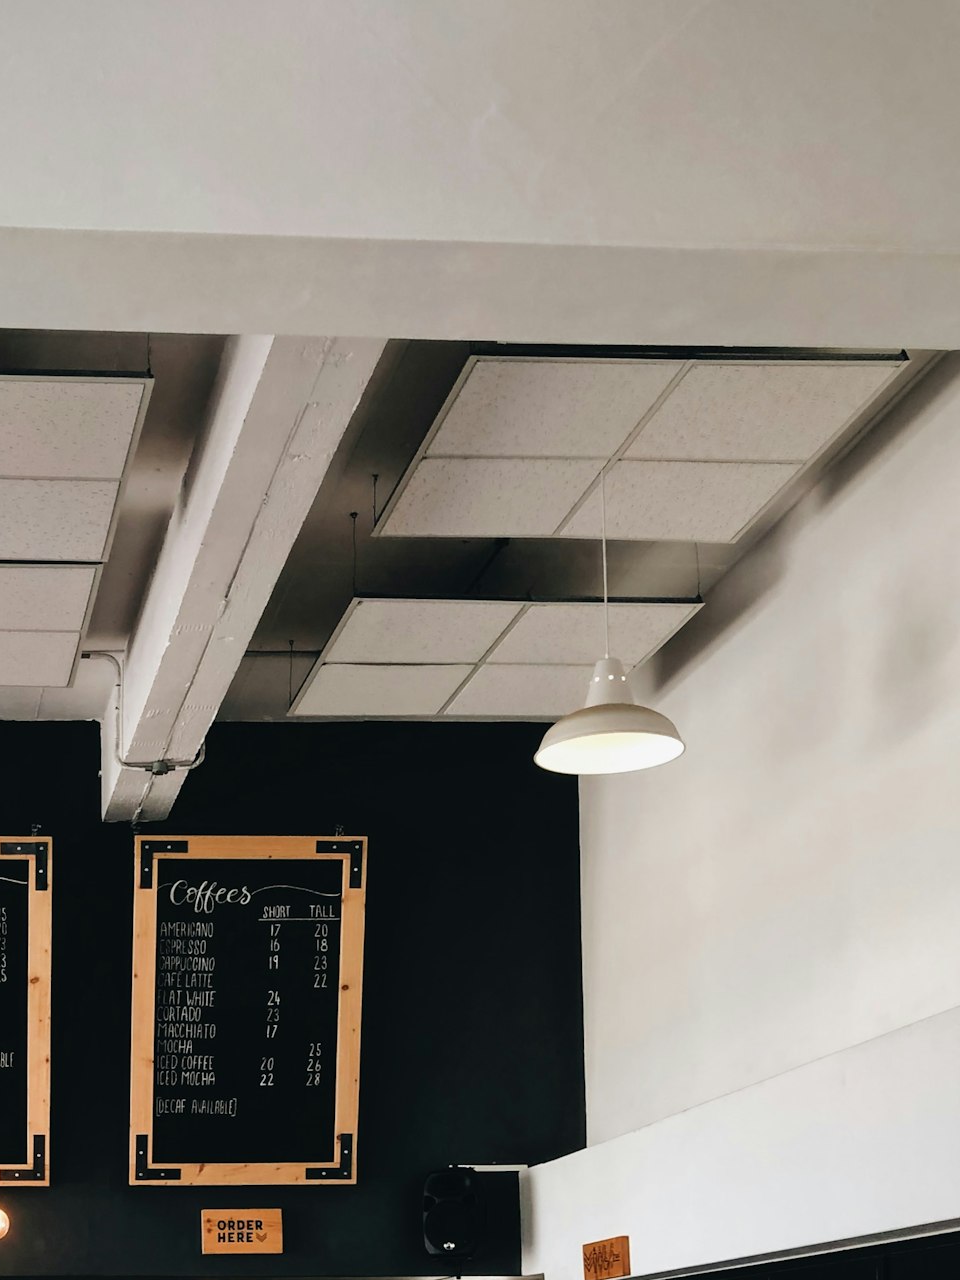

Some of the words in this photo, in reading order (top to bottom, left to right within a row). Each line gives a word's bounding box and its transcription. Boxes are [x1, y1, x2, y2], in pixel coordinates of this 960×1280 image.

[169, 880, 252, 914] Coffees
[262, 905, 291, 918] SHORT
[309, 904, 335, 917] TALL
[160, 921, 214, 938] AMERICANO
[270, 923, 281, 937] 17
[314, 923, 328, 937] 20
[160, 939, 207, 955] ESPRESSO
[270, 938, 280, 952] 16
[316, 938, 328, 952] 18
[159, 955, 215, 971] CAPPUCCINO
[268, 954, 279, 970] 19
[314, 955, 327, 971] 23
[185, 973, 213, 988] LATTE
[313, 973, 327, 988] 22
[157, 990, 183, 1005] FLAT
[186, 990, 217, 1007] WHITE
[267, 990, 281, 1006] 24
[156, 1006, 202, 1022] CORTADO
[266, 1007, 280, 1022] 23
[157, 1022, 217, 1039] MACCHIATO
[266, 1024, 278, 1038] 17
[157, 1039, 193, 1054] MOCHA
[309, 1042, 322, 1057] 25
[156, 1054, 178, 1070] ICED
[181, 1055, 215, 1071] COFFEE
[260, 1057, 274, 1071] 20
[306, 1058, 322, 1072] 26
[156, 1070, 178, 1086] ICED
[180, 1071, 216, 1086] MOCHA
[259, 1073, 275, 1086] 22
[305, 1073, 321, 1086] 28
[217, 1220, 263, 1231] ORDER
[217, 1232, 253, 1243] HERE
